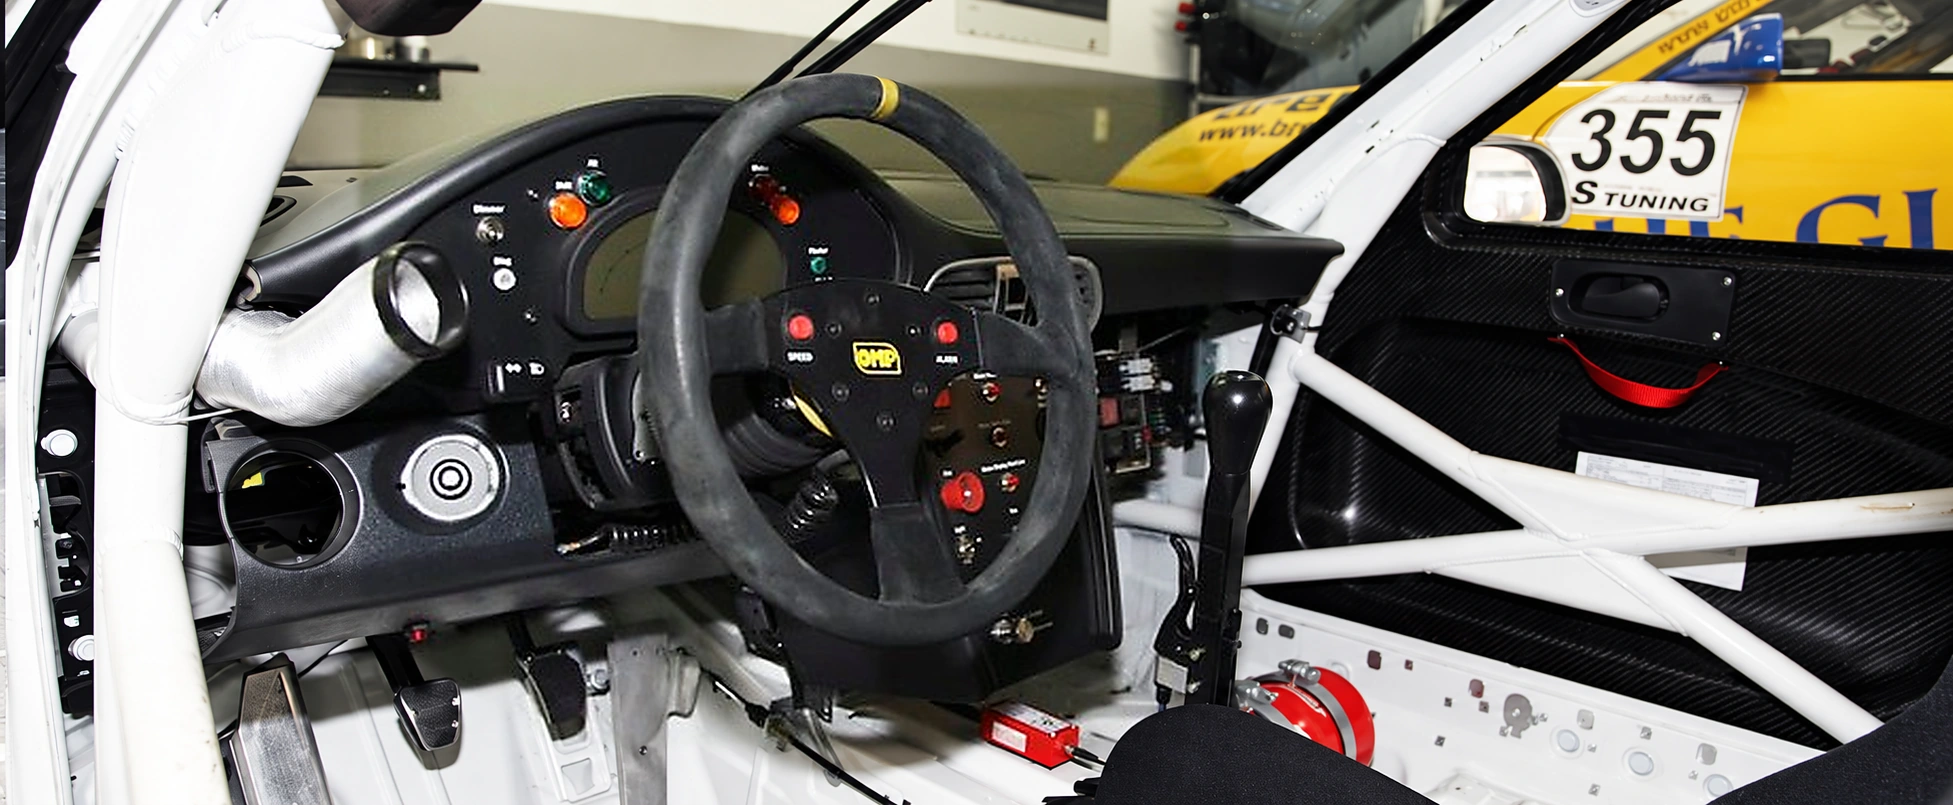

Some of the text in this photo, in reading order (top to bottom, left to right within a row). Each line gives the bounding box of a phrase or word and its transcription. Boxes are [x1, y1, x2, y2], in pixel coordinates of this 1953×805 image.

[1571, 108, 1722, 177] 355
[1604, 192, 1709, 212] TUNING
[787, 352, 813, 362] SPEED
[857, 348, 897, 368] OMP
